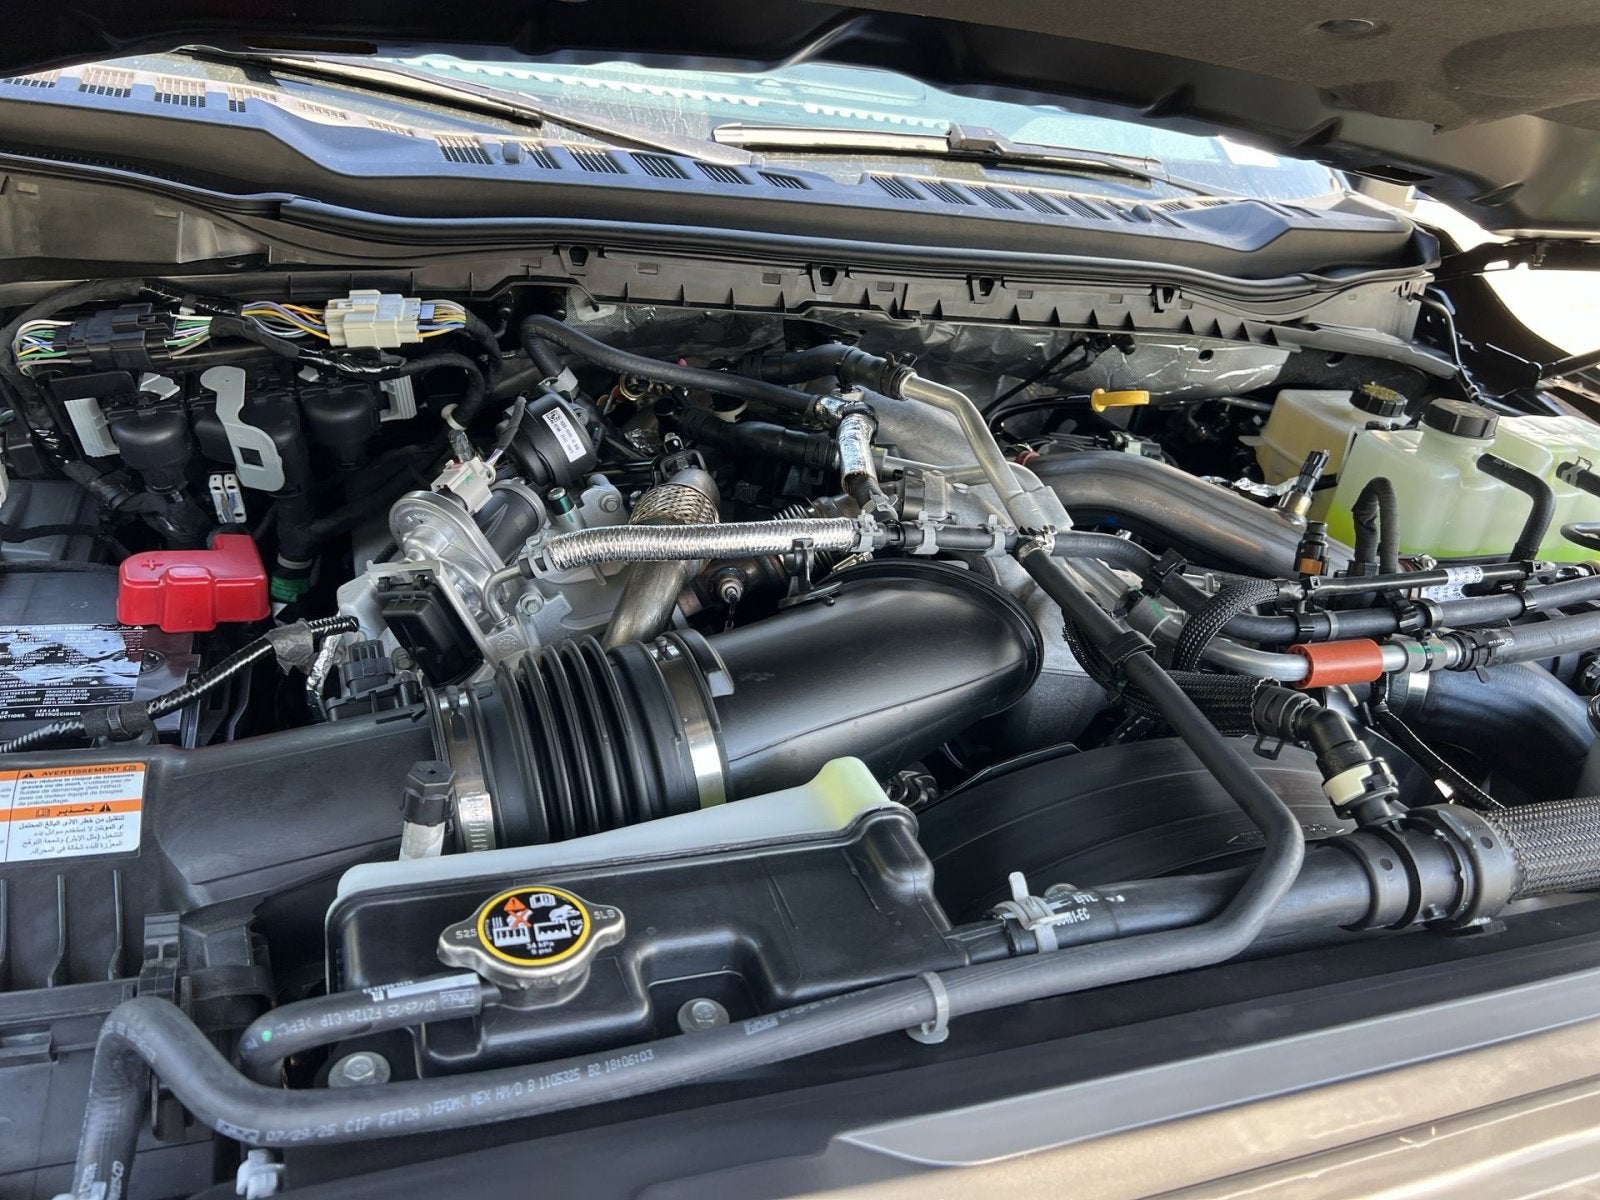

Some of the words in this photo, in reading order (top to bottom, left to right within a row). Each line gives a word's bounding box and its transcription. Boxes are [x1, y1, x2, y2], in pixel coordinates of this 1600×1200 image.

[41, 766, 120, 776] AVERTISSEMENT
[570, 919, 583, 928] OK
[537, 941, 555, 949] kPa
[538, 947, 553, 955] psi
[387, 998, 436, 1018] 07/29/25
[344, 1116, 372, 1134] CIP
[604, 1048, 654, 1074] 18:06:03
